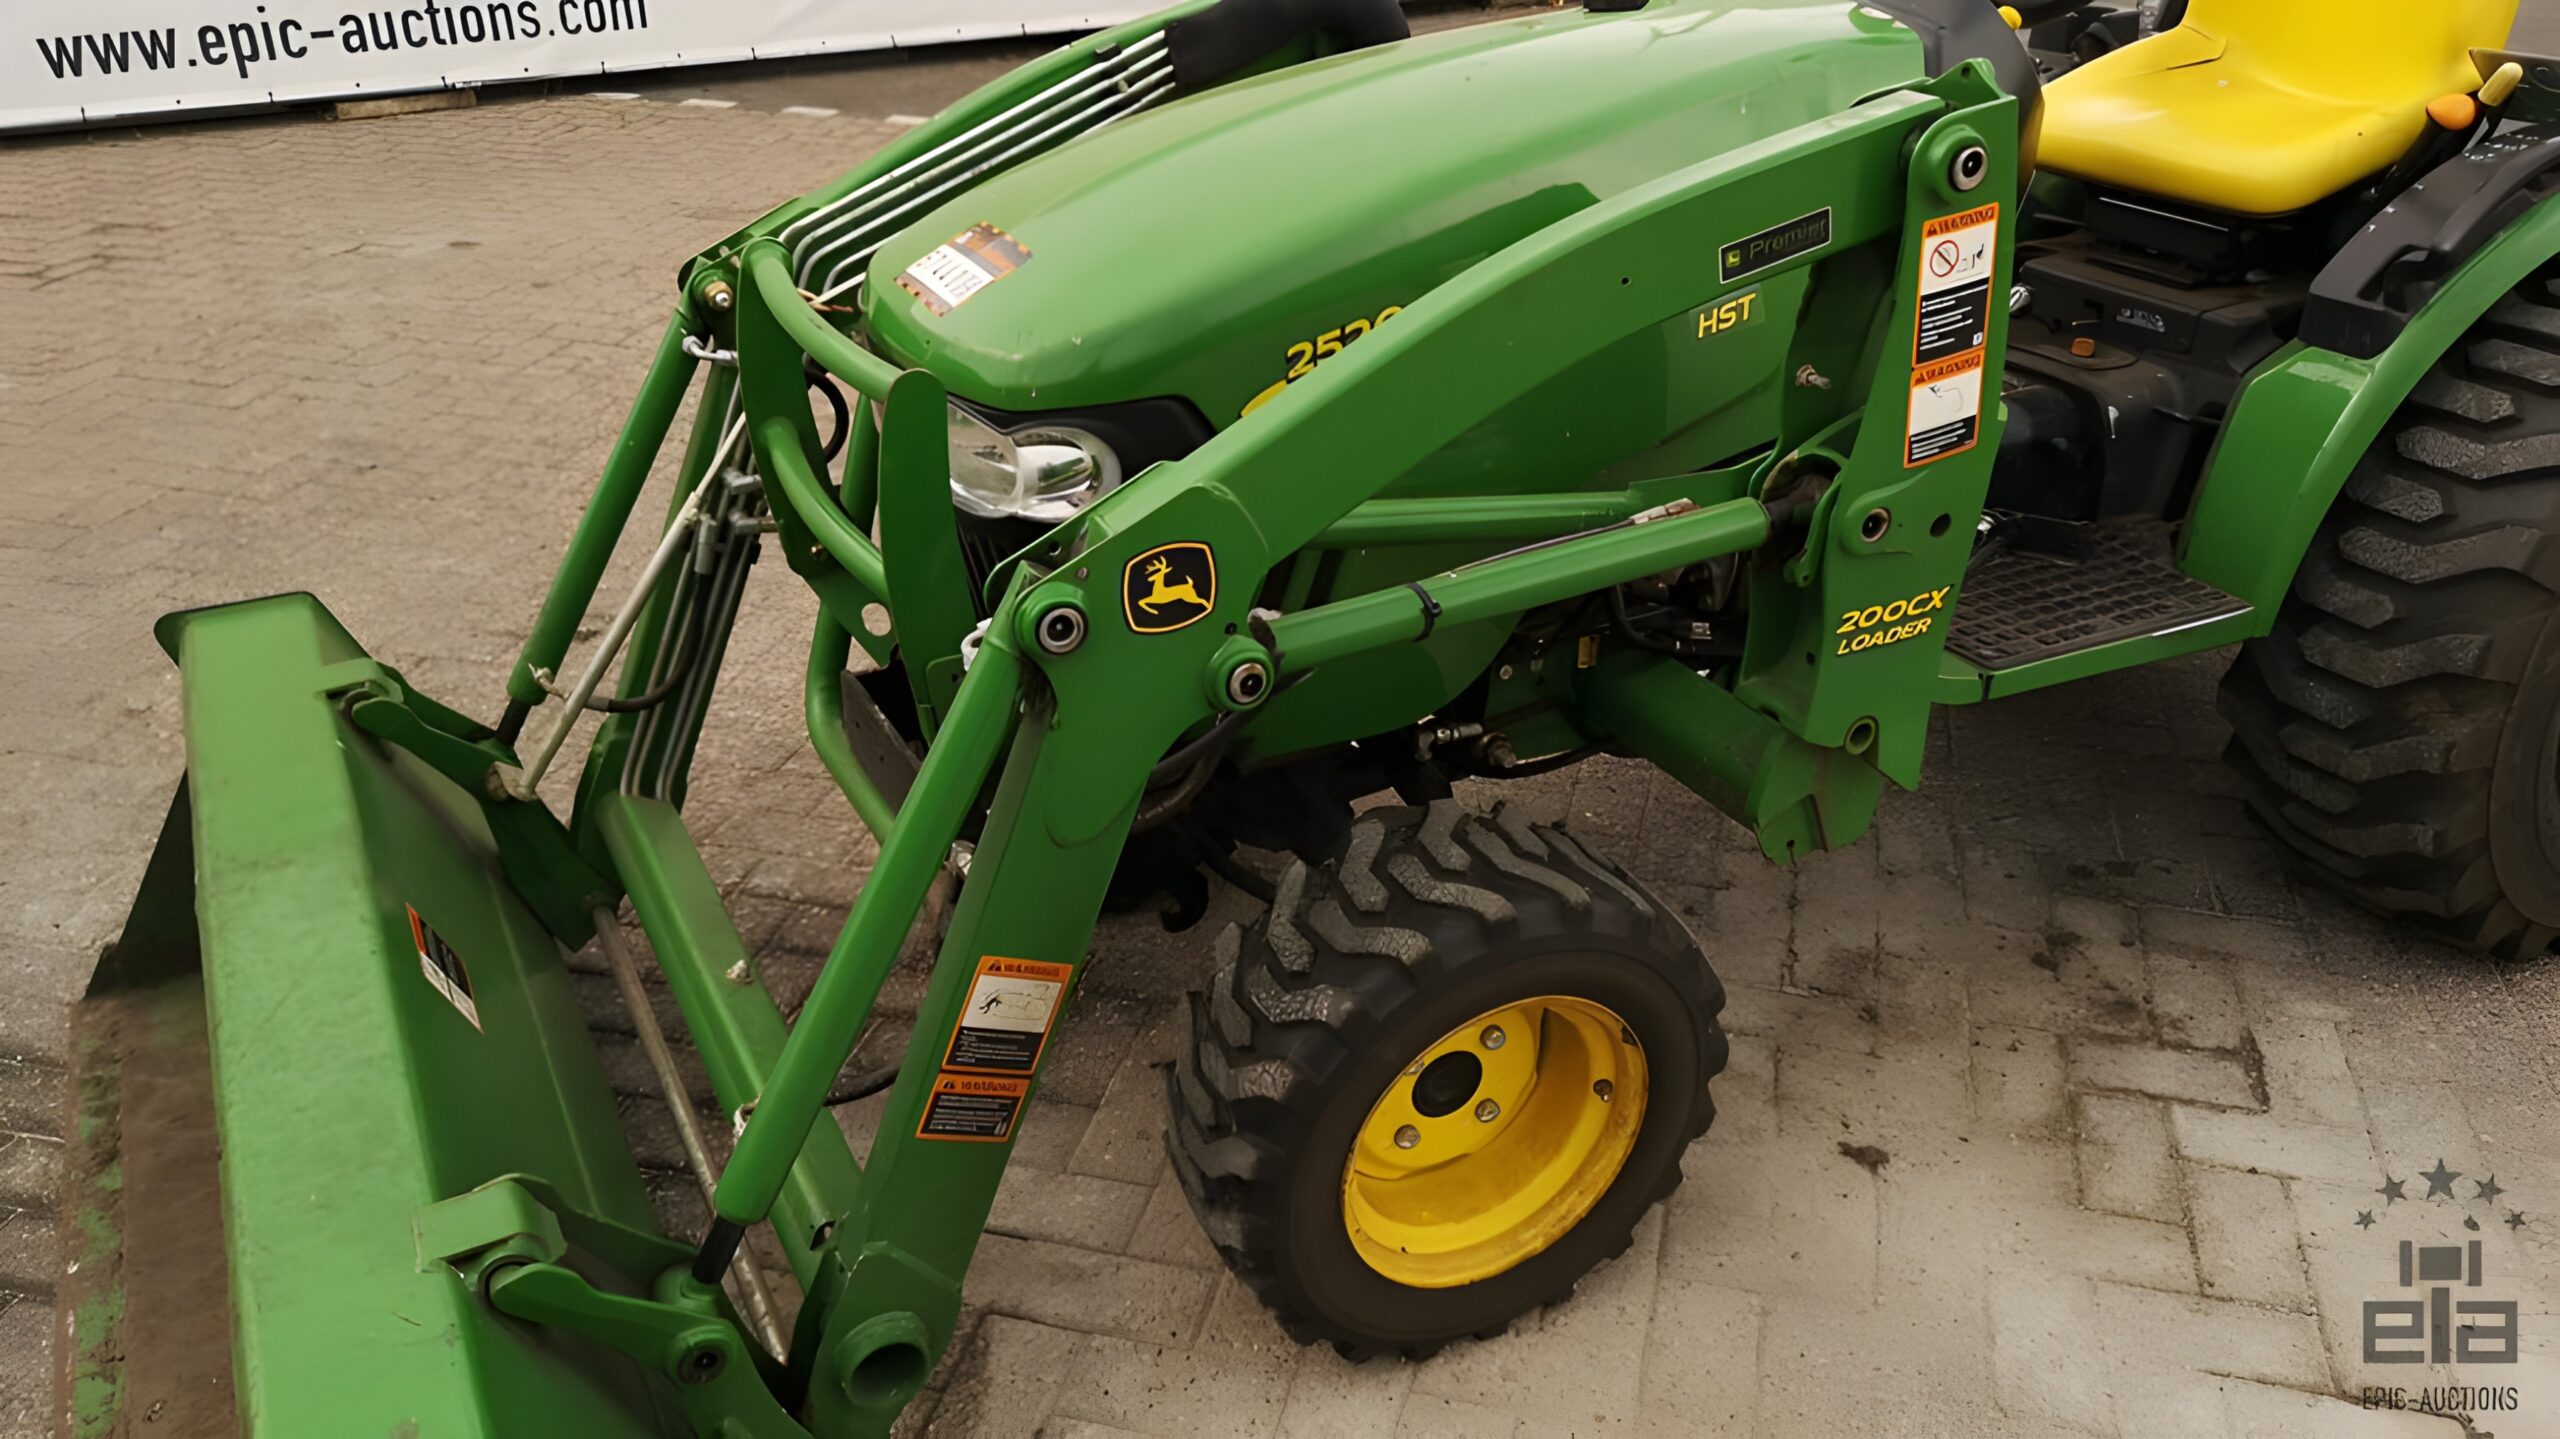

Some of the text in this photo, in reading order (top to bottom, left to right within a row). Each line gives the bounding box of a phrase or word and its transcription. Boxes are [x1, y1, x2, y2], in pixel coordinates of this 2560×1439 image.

[36, 0, 648, 79] www.epic-auctions.com
[1697, 292, 1757, 339] HST
[1285, 305, 1403, 380] 25
[1836, 585, 1953, 634] 200CX
[1836, 617, 1932, 655] LOADER
